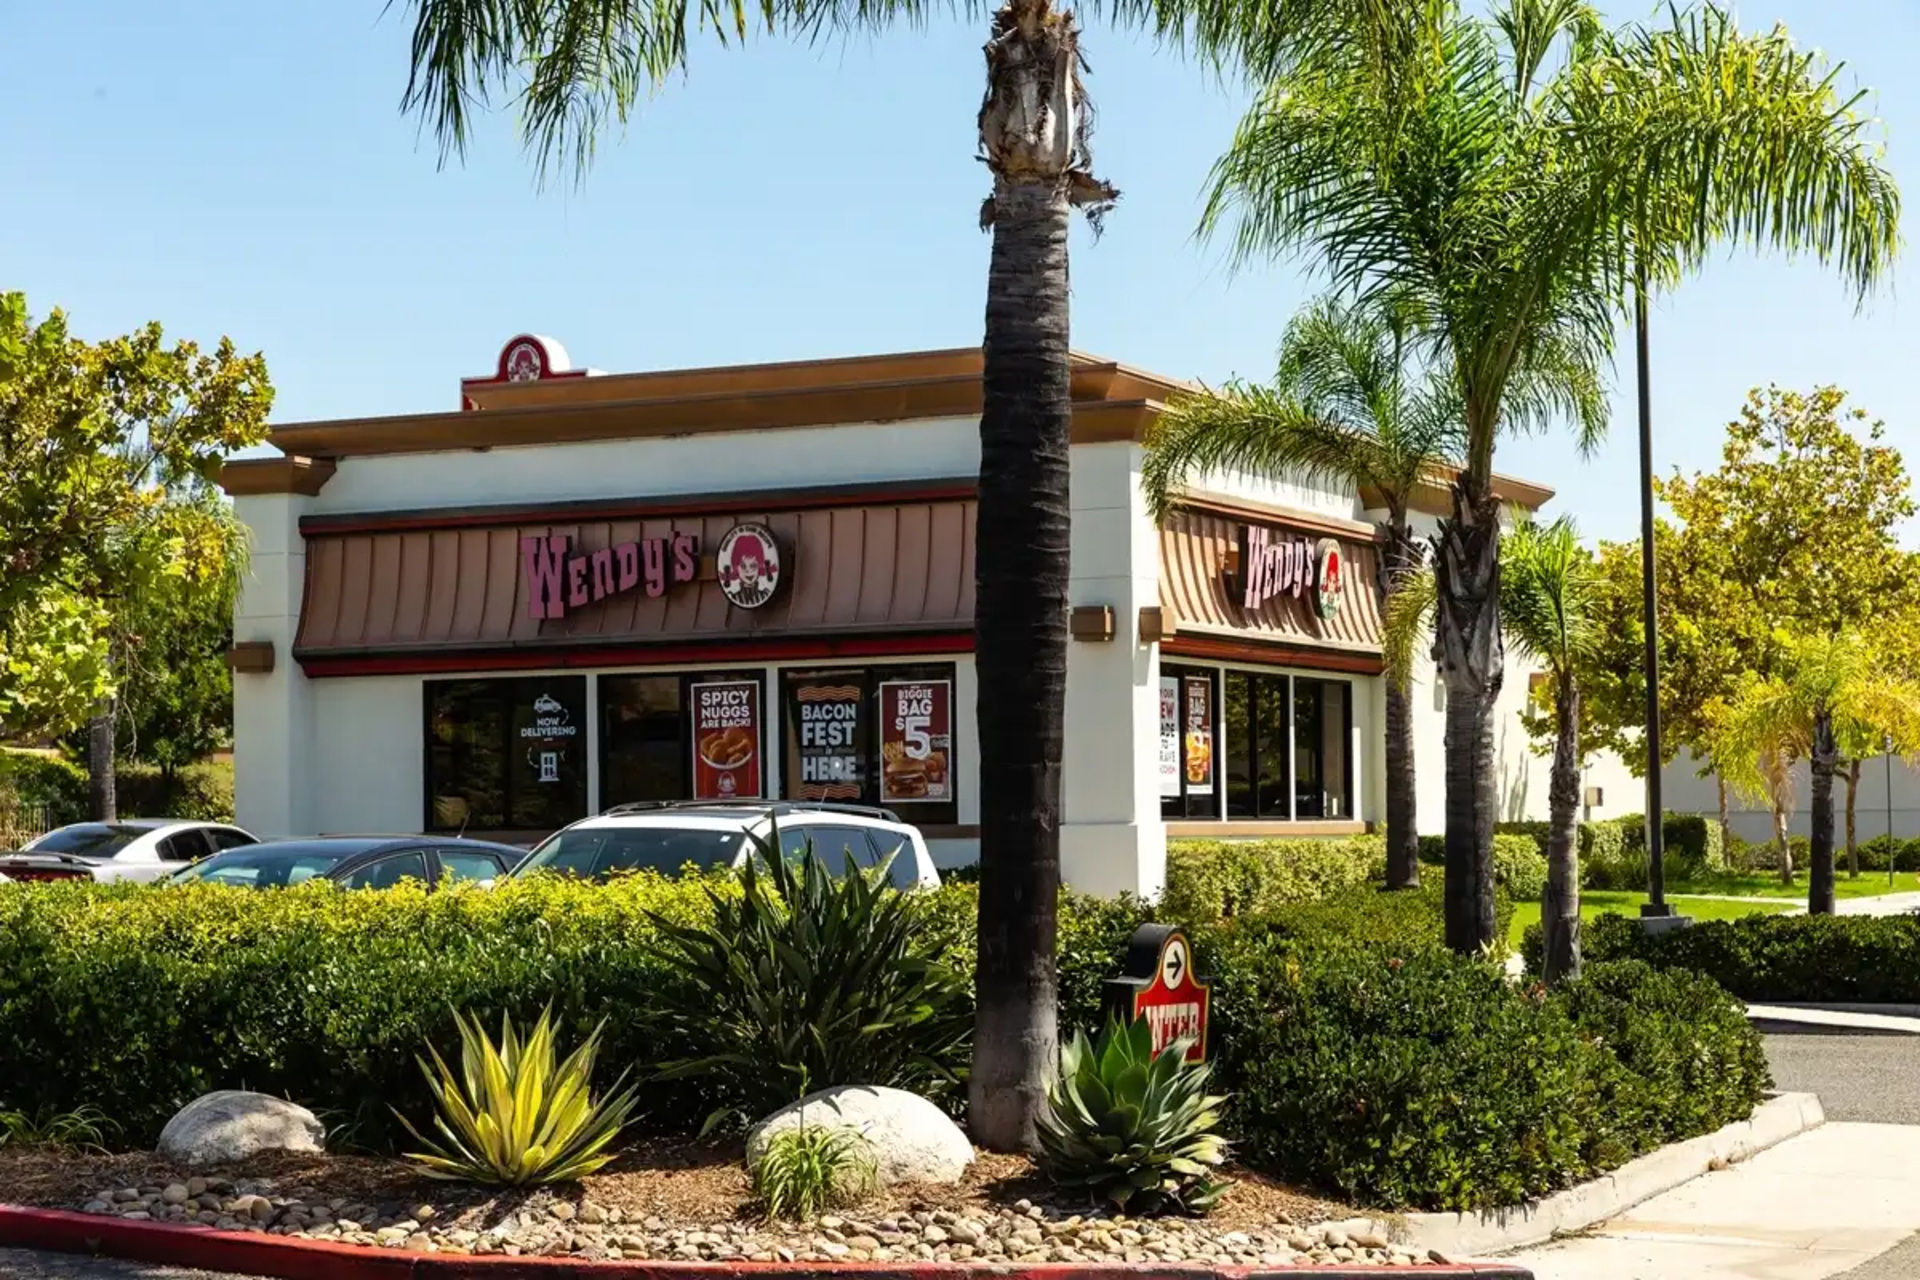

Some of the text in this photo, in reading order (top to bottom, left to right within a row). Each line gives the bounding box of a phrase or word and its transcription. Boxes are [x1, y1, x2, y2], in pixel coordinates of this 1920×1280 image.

[701, 690, 750, 706] SPICY
[701, 705, 750, 719] NUGGS
[802, 703, 856, 720] BACON
[897, 699, 933, 716] BAG
[1160, 701, 1175, 719] EW
[537, 717, 560, 726] NOW
[701, 720, 720, 729] ARE
[521, 726, 576, 737] DELIVERING
[802, 721, 856, 746] FEST
[803, 756, 857, 781] HERE
[1140, 1002, 1200, 1051] NTER
